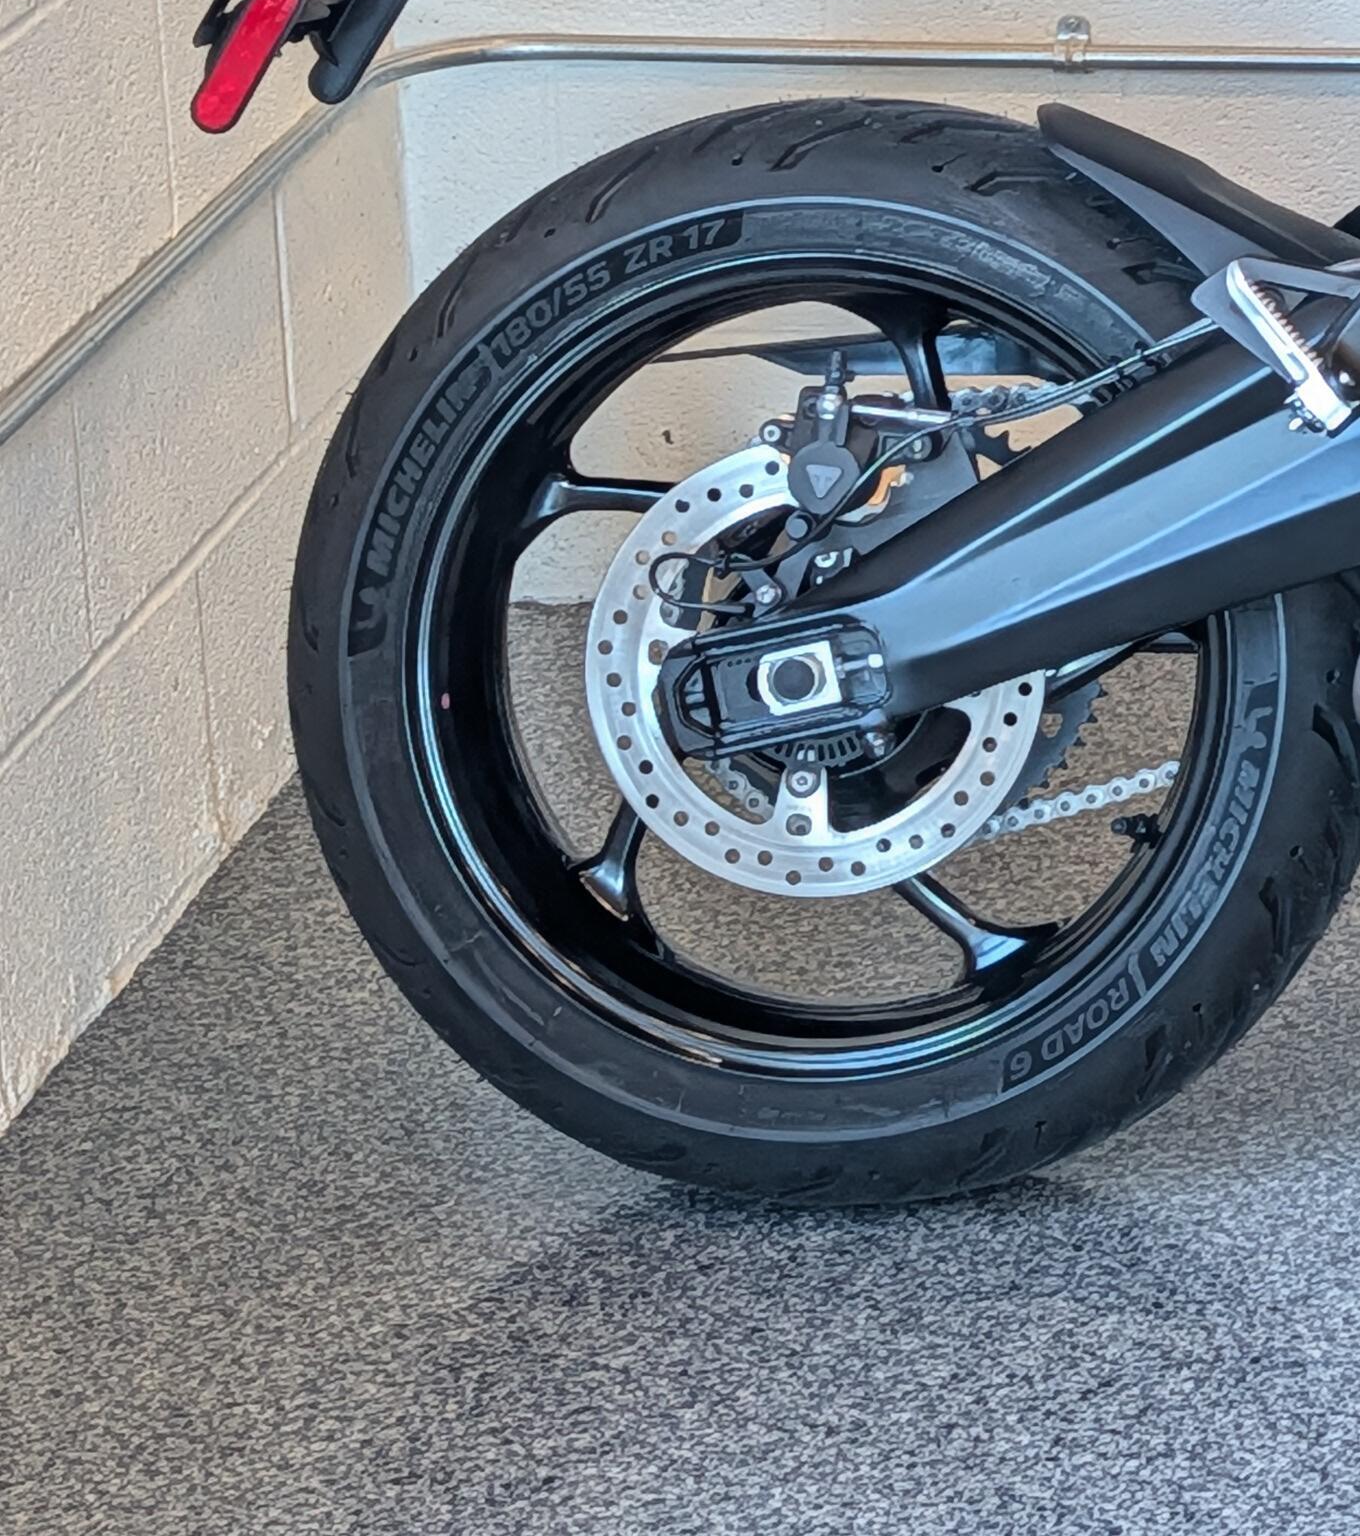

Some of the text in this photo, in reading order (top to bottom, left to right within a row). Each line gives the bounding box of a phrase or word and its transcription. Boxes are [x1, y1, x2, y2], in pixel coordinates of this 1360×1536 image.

[366, 218, 726, 578] MICHELIN 180/55 ZR 17
[1009, 760, 1261, 1081] MICHELIN ROAD 6
